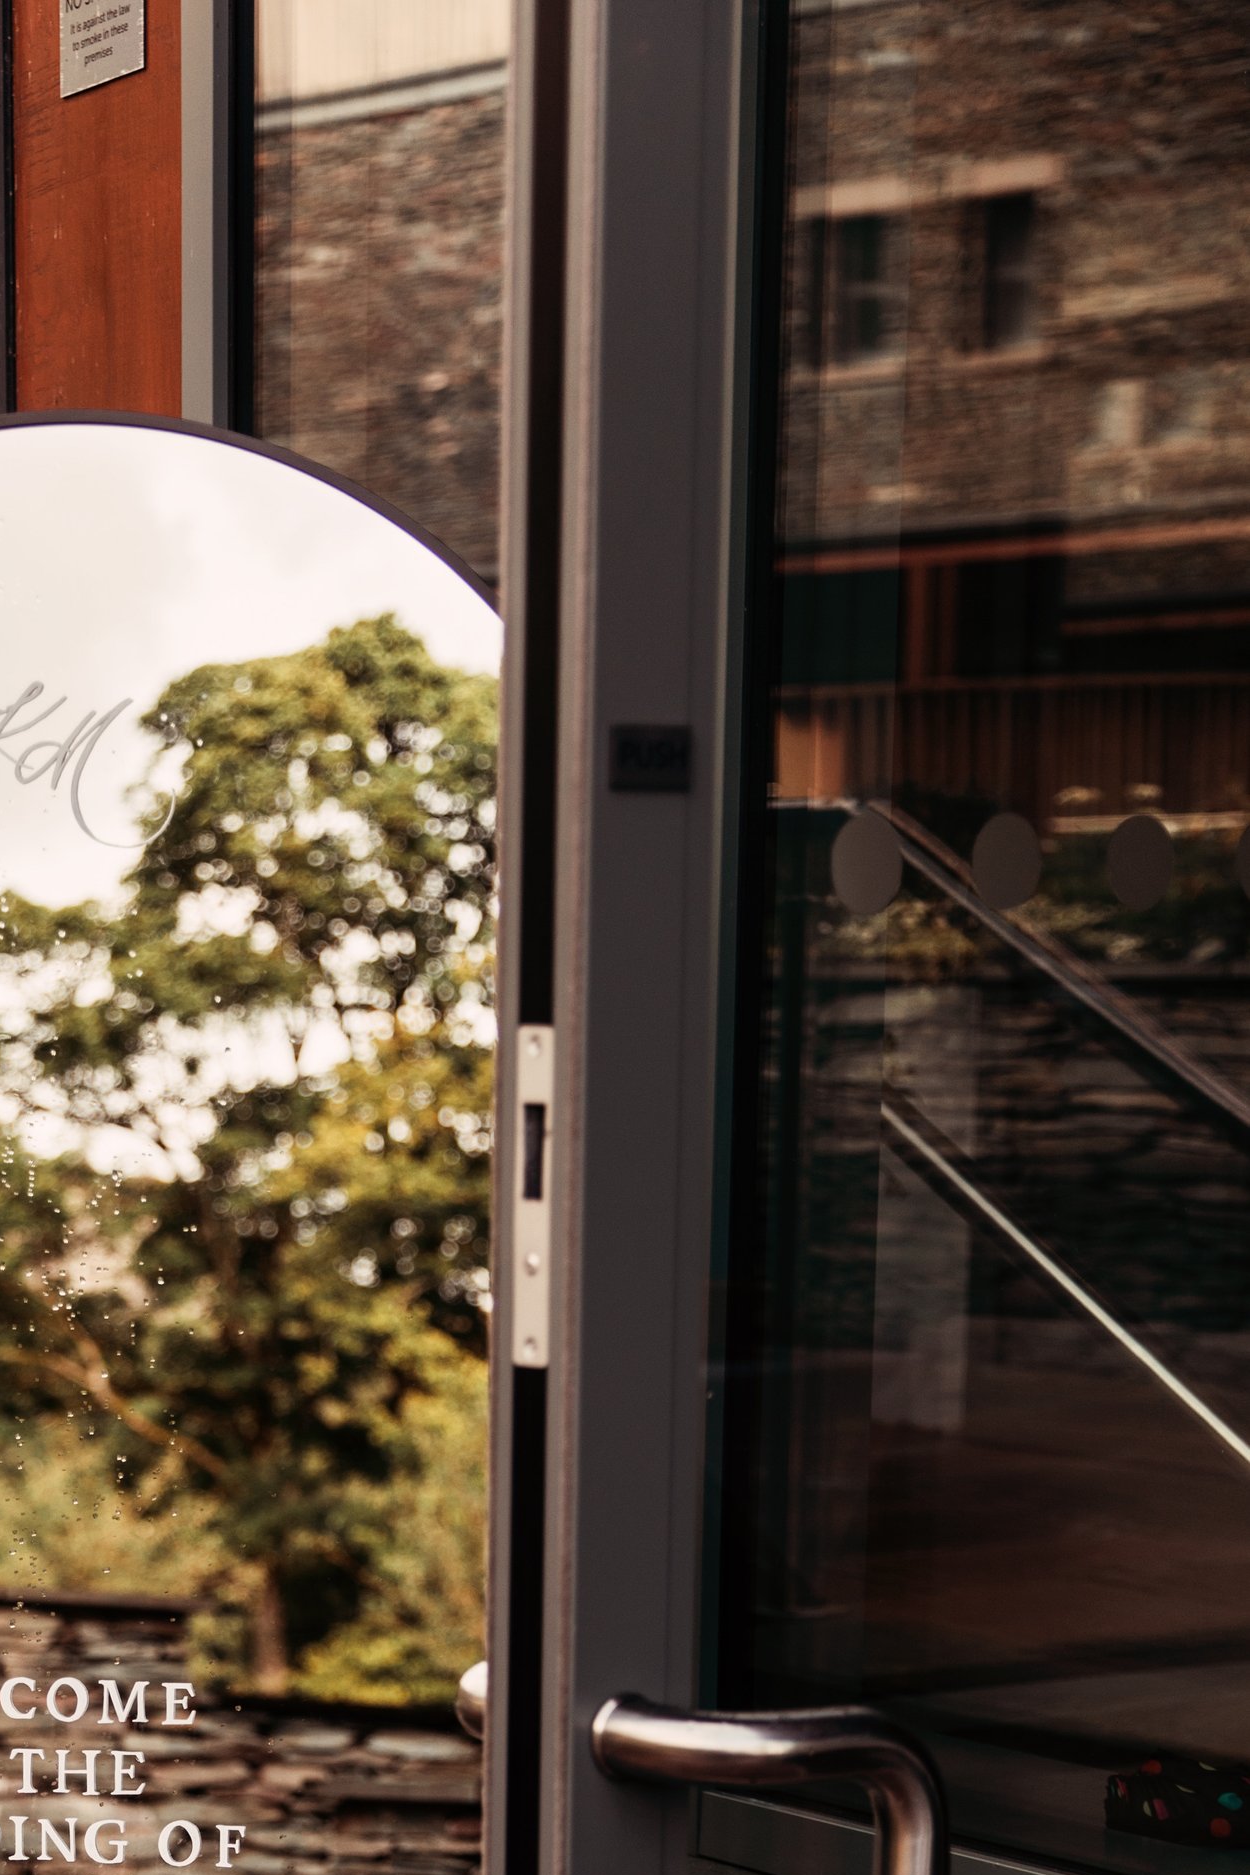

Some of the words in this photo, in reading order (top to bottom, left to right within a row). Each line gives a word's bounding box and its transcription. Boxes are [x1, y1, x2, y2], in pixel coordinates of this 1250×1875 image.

[76, 21, 82, 33] is
[82, 13, 106, 32] against
[106, 8, 118, 21] the
[118, 4, 131, 16] law
[72, 41, 80, 52] to
[80, 32, 102, 49] smoke
[102, 28, 110, 40] in
[110, 22, 129, 37] these
[83, 46, 114, 68] premises
[621, 741, 687, 769] PUSH
[8, 1747, 147, 1797] THE
[157, 1817, 247, 1869] OF
